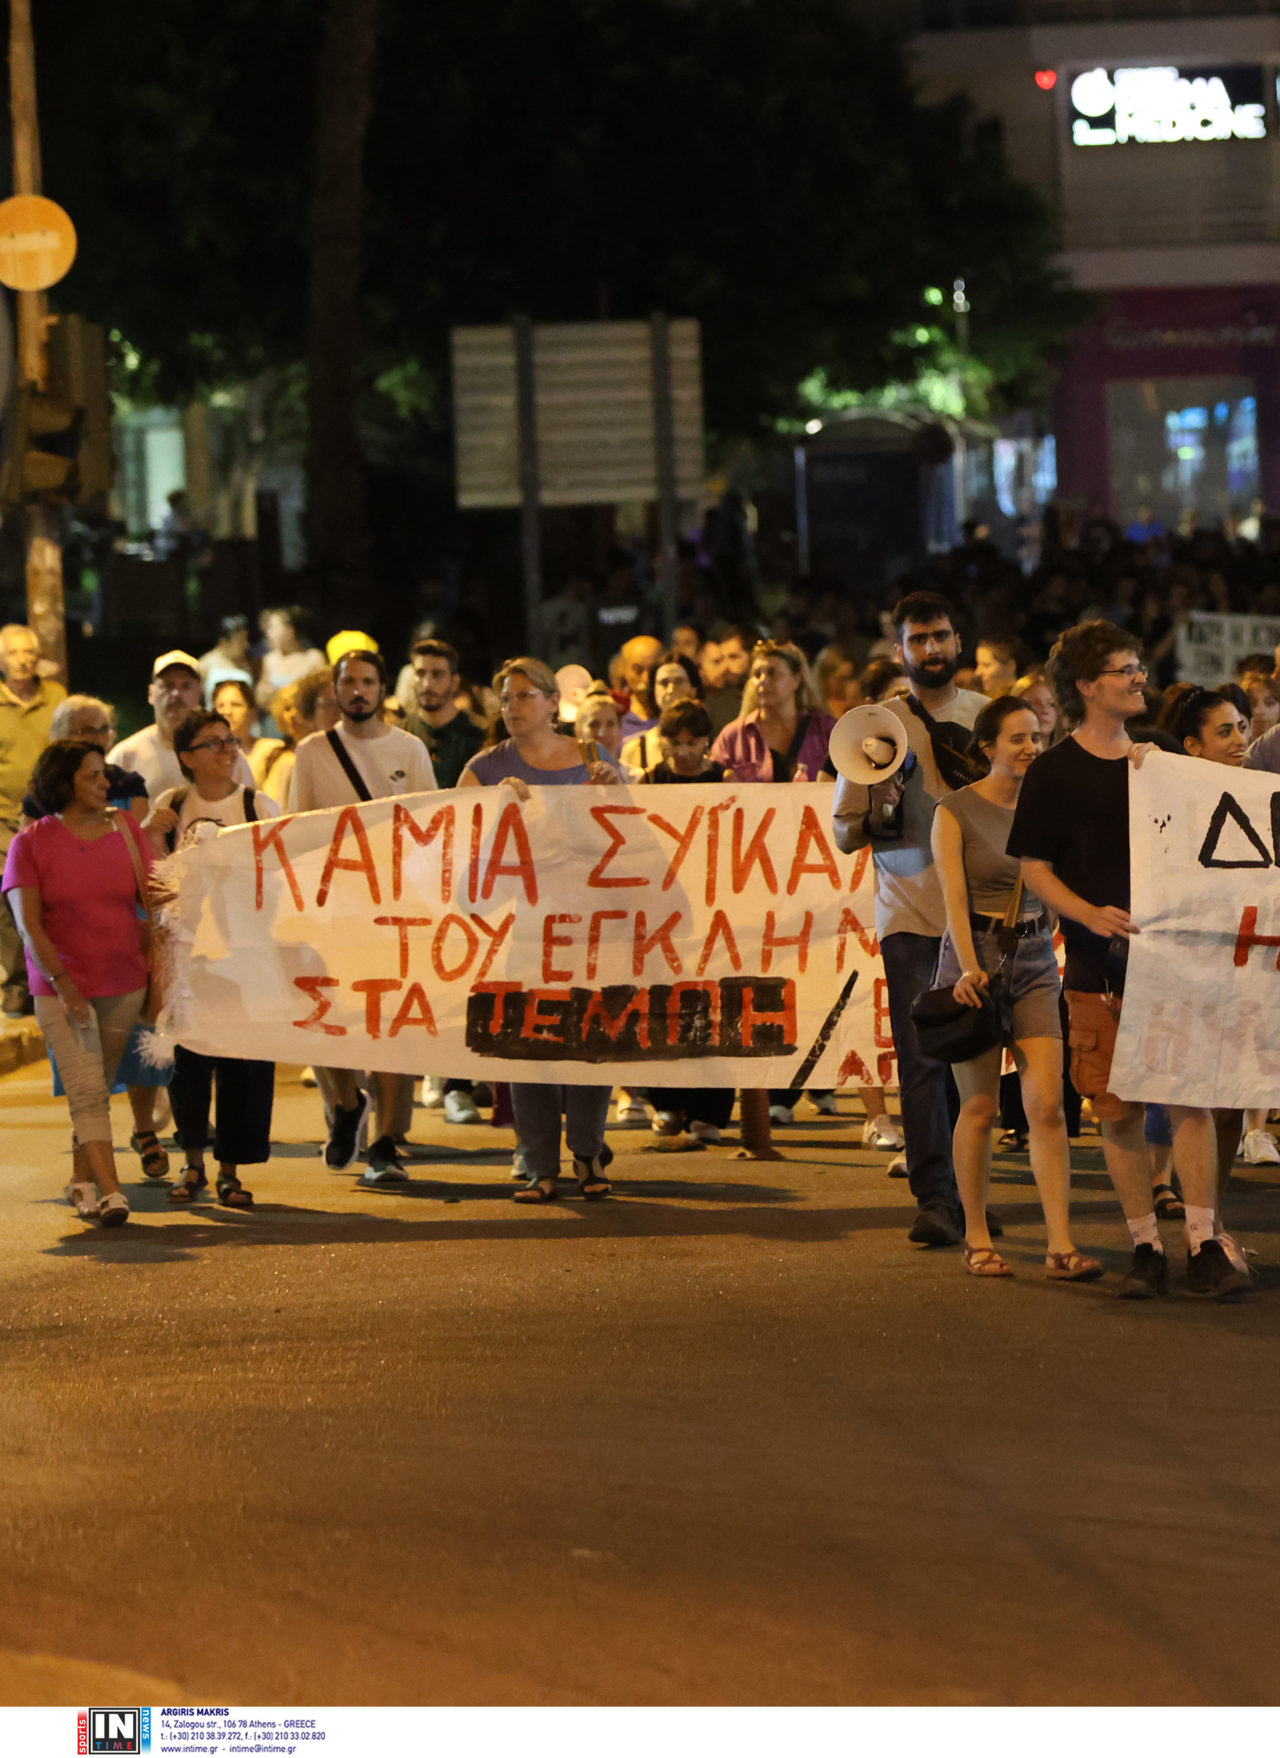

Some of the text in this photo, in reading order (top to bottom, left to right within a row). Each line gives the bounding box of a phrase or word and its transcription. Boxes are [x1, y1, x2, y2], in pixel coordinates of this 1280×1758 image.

[251, 803, 539, 912] ΚΑΜΙΑ
[374, 912, 517, 984] ΤΟΥ
[293, 976, 440, 1040] ΣΤΑ
[470, 976, 798, 1050] ΤΕΜΠΗ
